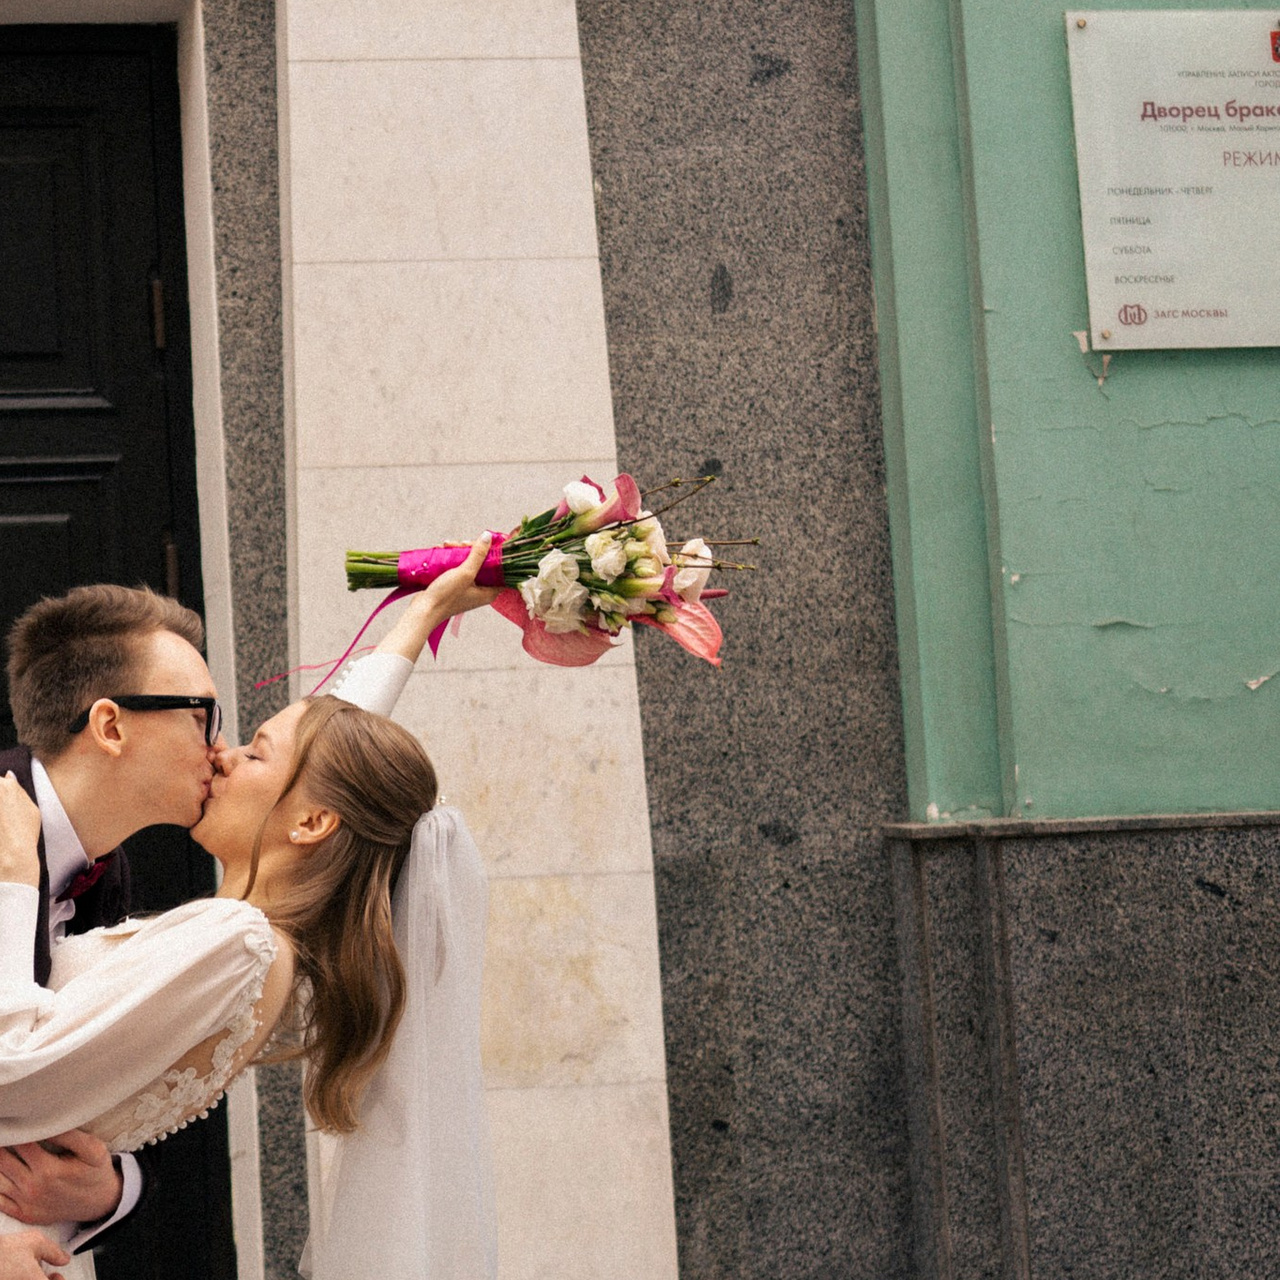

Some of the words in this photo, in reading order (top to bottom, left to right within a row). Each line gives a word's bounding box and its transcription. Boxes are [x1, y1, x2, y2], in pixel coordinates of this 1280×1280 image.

[1141, 101, 1220, 122] Дворец
[1107, 187, 1173, 196] ПОНЕДЕЛЬНИК
[1110, 217, 1151, 225] ПЯТНИЦА
[1112, 246, 1152, 255] СУББОТА
[1115, 275, 1174, 284] ВОСКРЕСЕНЬЕ
[1154, 309, 1179, 319] ЗАГС
[1182, 309, 1228, 318] МОСКВЫ
